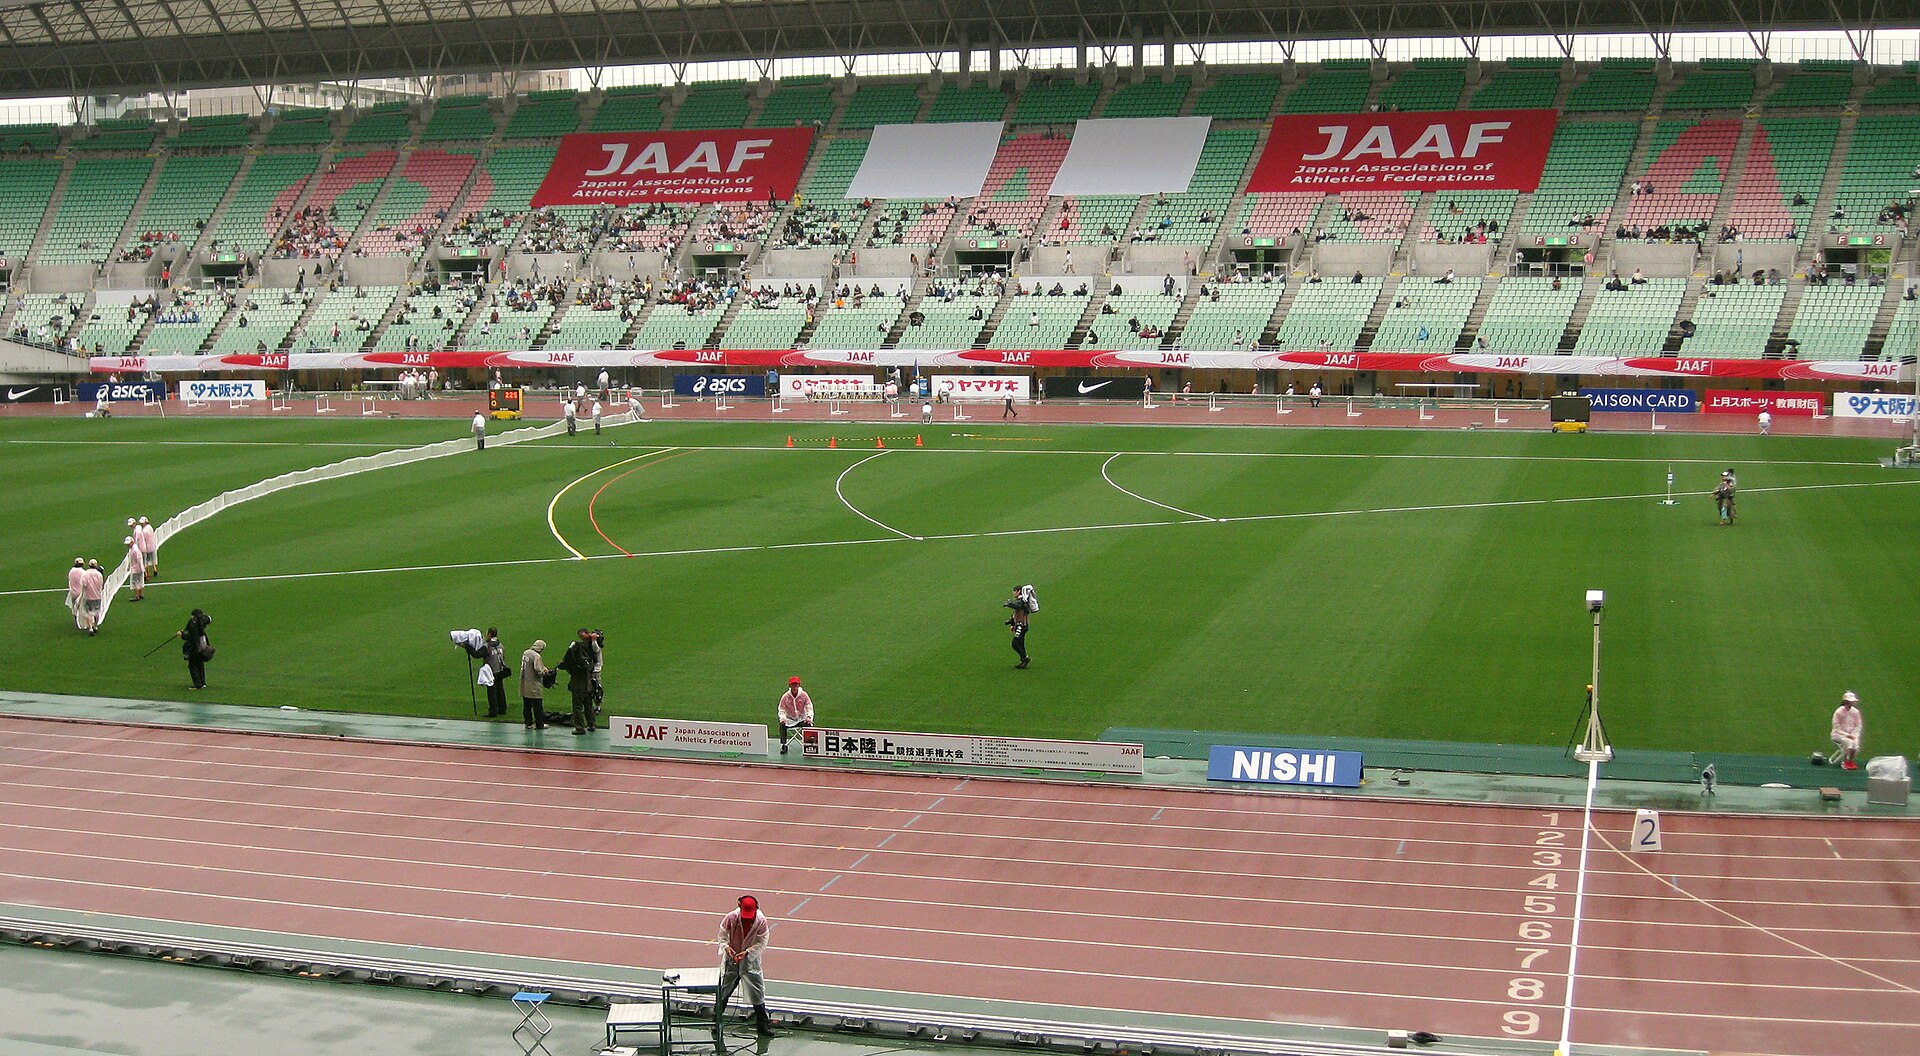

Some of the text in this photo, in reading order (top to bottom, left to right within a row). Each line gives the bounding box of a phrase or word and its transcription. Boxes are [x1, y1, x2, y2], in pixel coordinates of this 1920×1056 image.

[1302, 122, 1512, 160] JAAF
[585, 139, 773, 176] JAAF
[1295, 162, 1494, 174] Japan Association of
[578, 176, 754, 189] Japan Association of
[1290, 172, 1496, 184] Athletics Federations
[572, 185, 754, 197] Athletics Federations
[260, 356, 286, 365] JAAF
[402, 353, 430, 364] JAAF
[548, 353, 574, 362] JAAF
[695, 351, 722, 361] JAAF
[846, 352, 874, 361] JAAF
[1001, 352, 1030, 362] JAAF
[1160, 352, 1190, 363] JAAF
[1324, 354, 1355, 365] JAAF
[1495, 356, 1529, 367] JAAF
[120, 358, 145, 367] JAAF
[1674, 360, 1708, 372] JAAF
[1862, 364, 1898, 375] JAAF
[207, 384, 255, 397] 大阪ガス
[958, 380, 1018, 392] ヤマザキ
[1586, 394, 1689, 407] SAISON CARD
[1710, 397, 1818, 410] 上月スポーツ・教育財団
[624, 723, 668, 741] JAAF
[675, 727, 696, 736] Japan
[698, 728, 739, 738] Association
[675, 735, 752, 747] Athletics Federations
[1232, 750, 1336, 783] NISHI
[1542, 813, 1559, 826] 1
[1640, 819, 1656, 845] 2
[1535, 832, 1565, 846] 2
[1532, 852, 1562, 866] 3
[1528, 873, 1558, 889] 4
[1524, 896, 1556, 914] 5
[1518, 921, 1552, 940] 6
[1515, 948, 1549, 968] 7
[1507, 978, 1545, 1001] 8
[1501, 1010, 1540, 1035] 9
